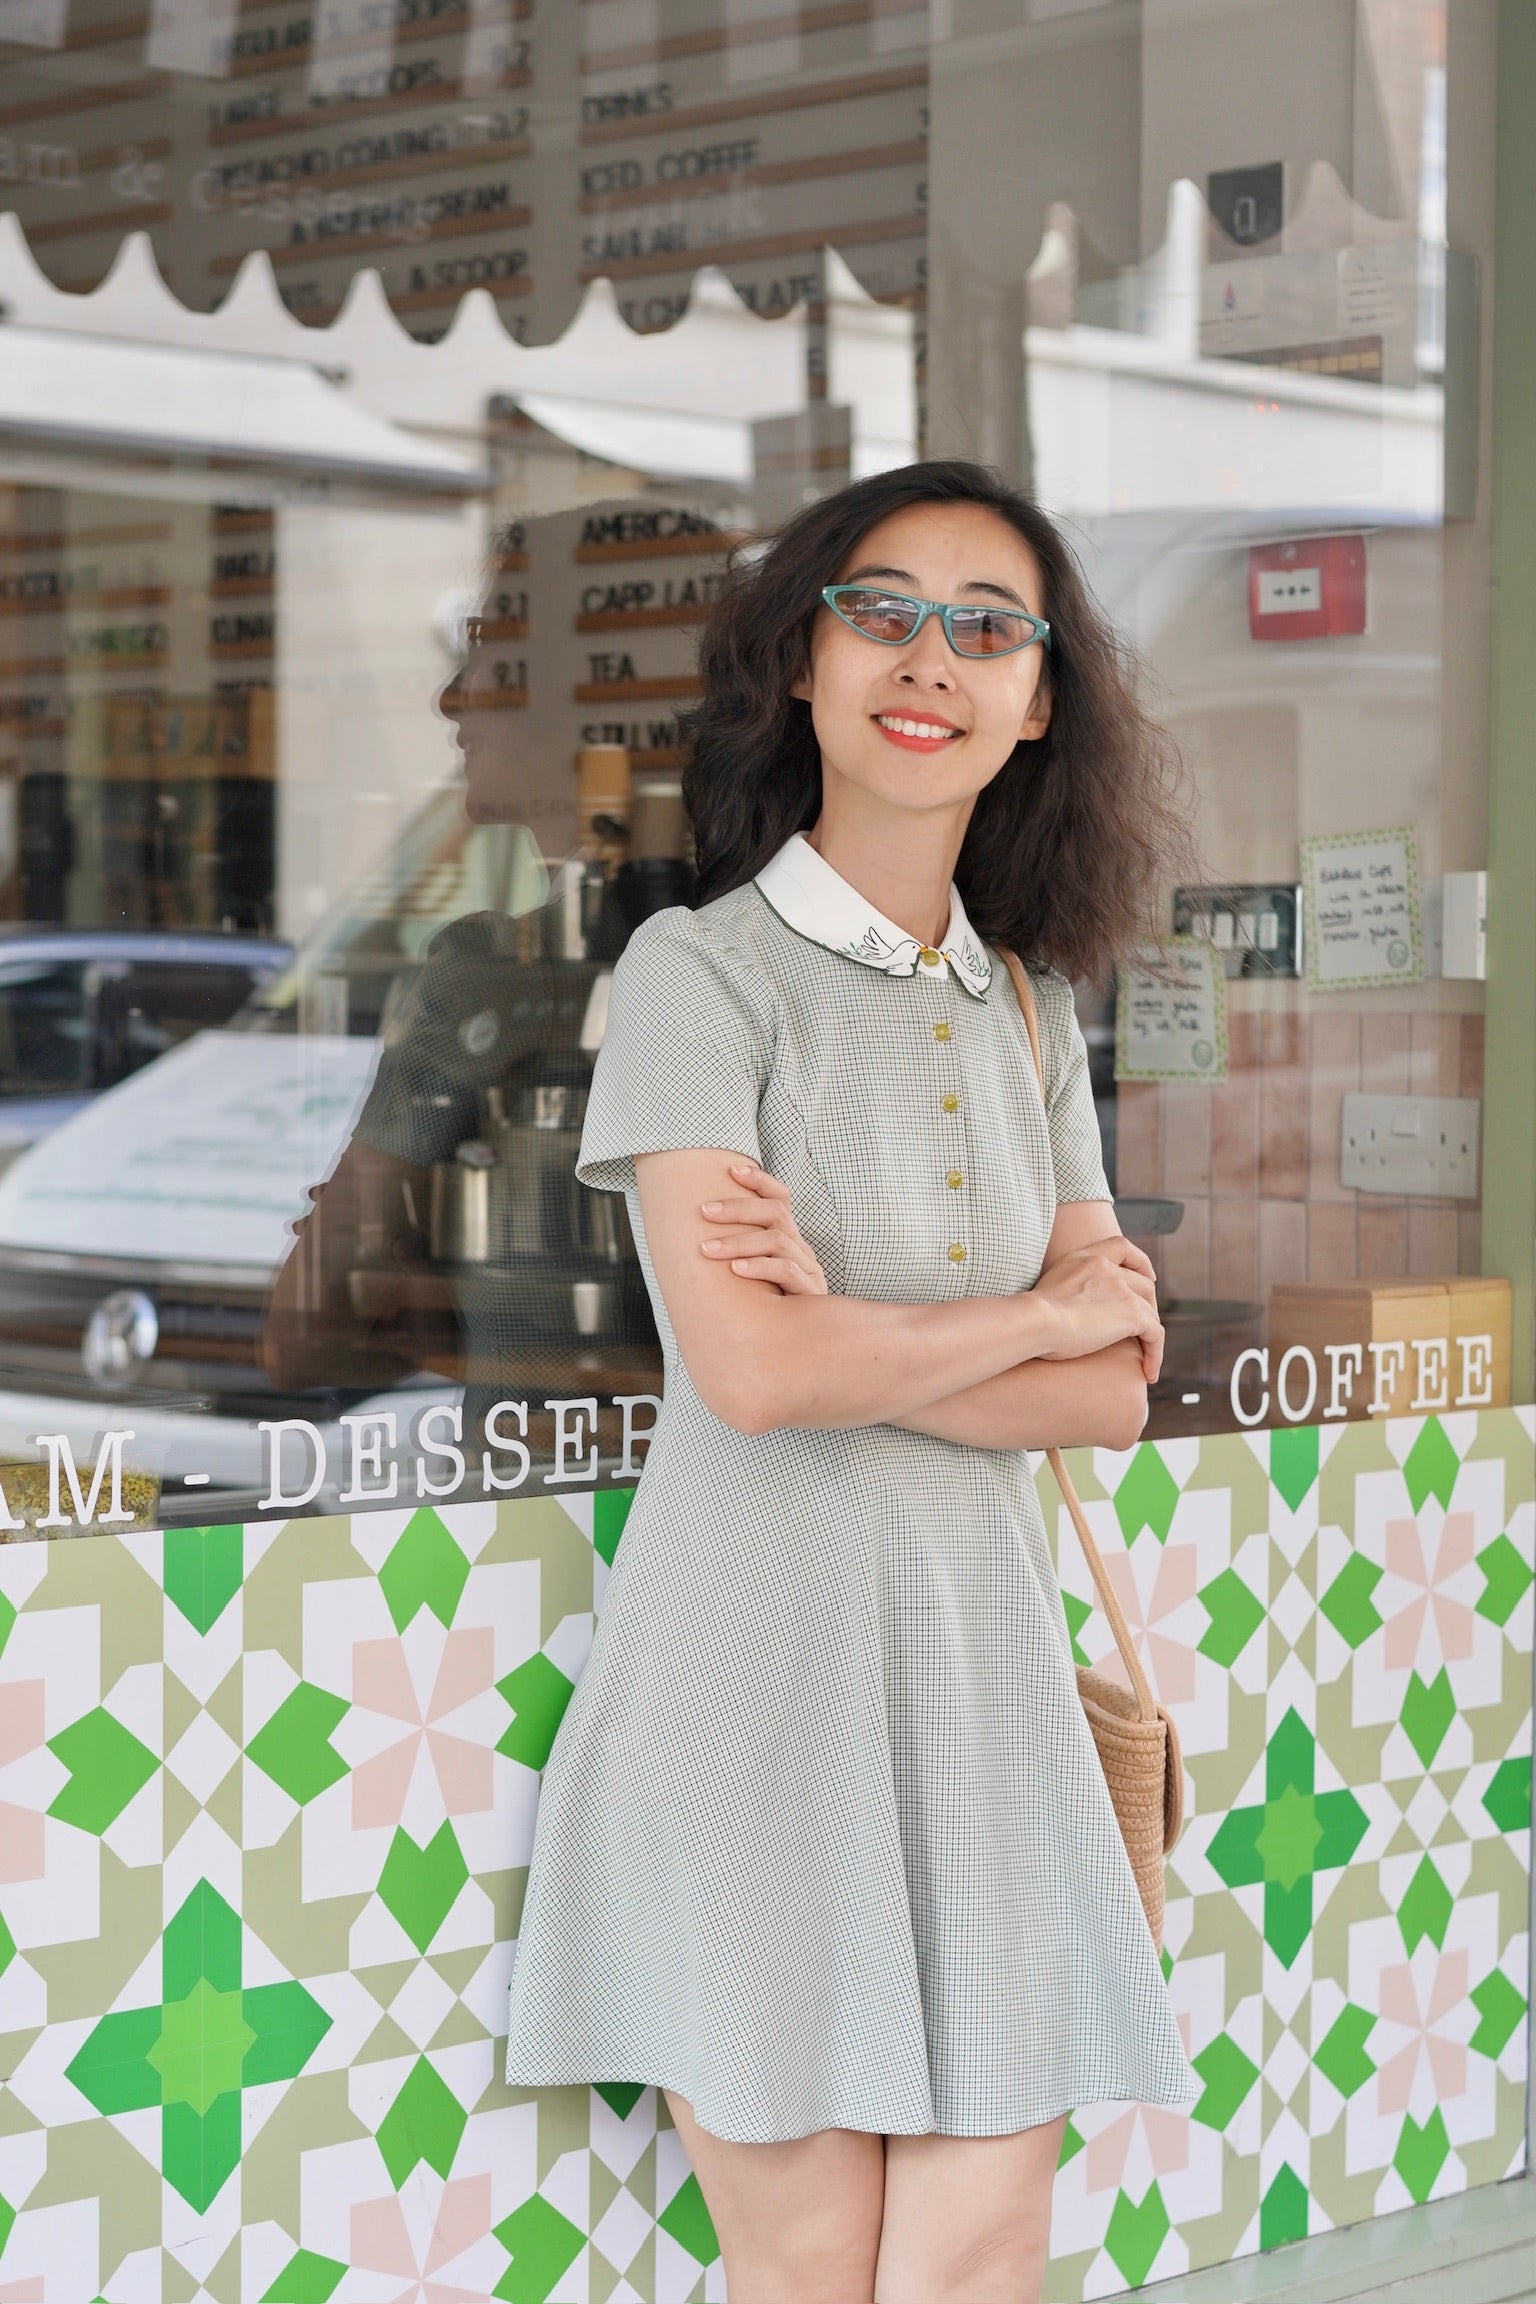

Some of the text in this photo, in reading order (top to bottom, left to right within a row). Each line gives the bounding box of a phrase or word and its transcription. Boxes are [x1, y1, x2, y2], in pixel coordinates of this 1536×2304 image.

[581, 82, 673, 123] DRINKS
[580, 158, 643, 196] ICED
[588, 652, 634, 685] TEA
[1230, 1334, 1492, 1427] COFFEE
